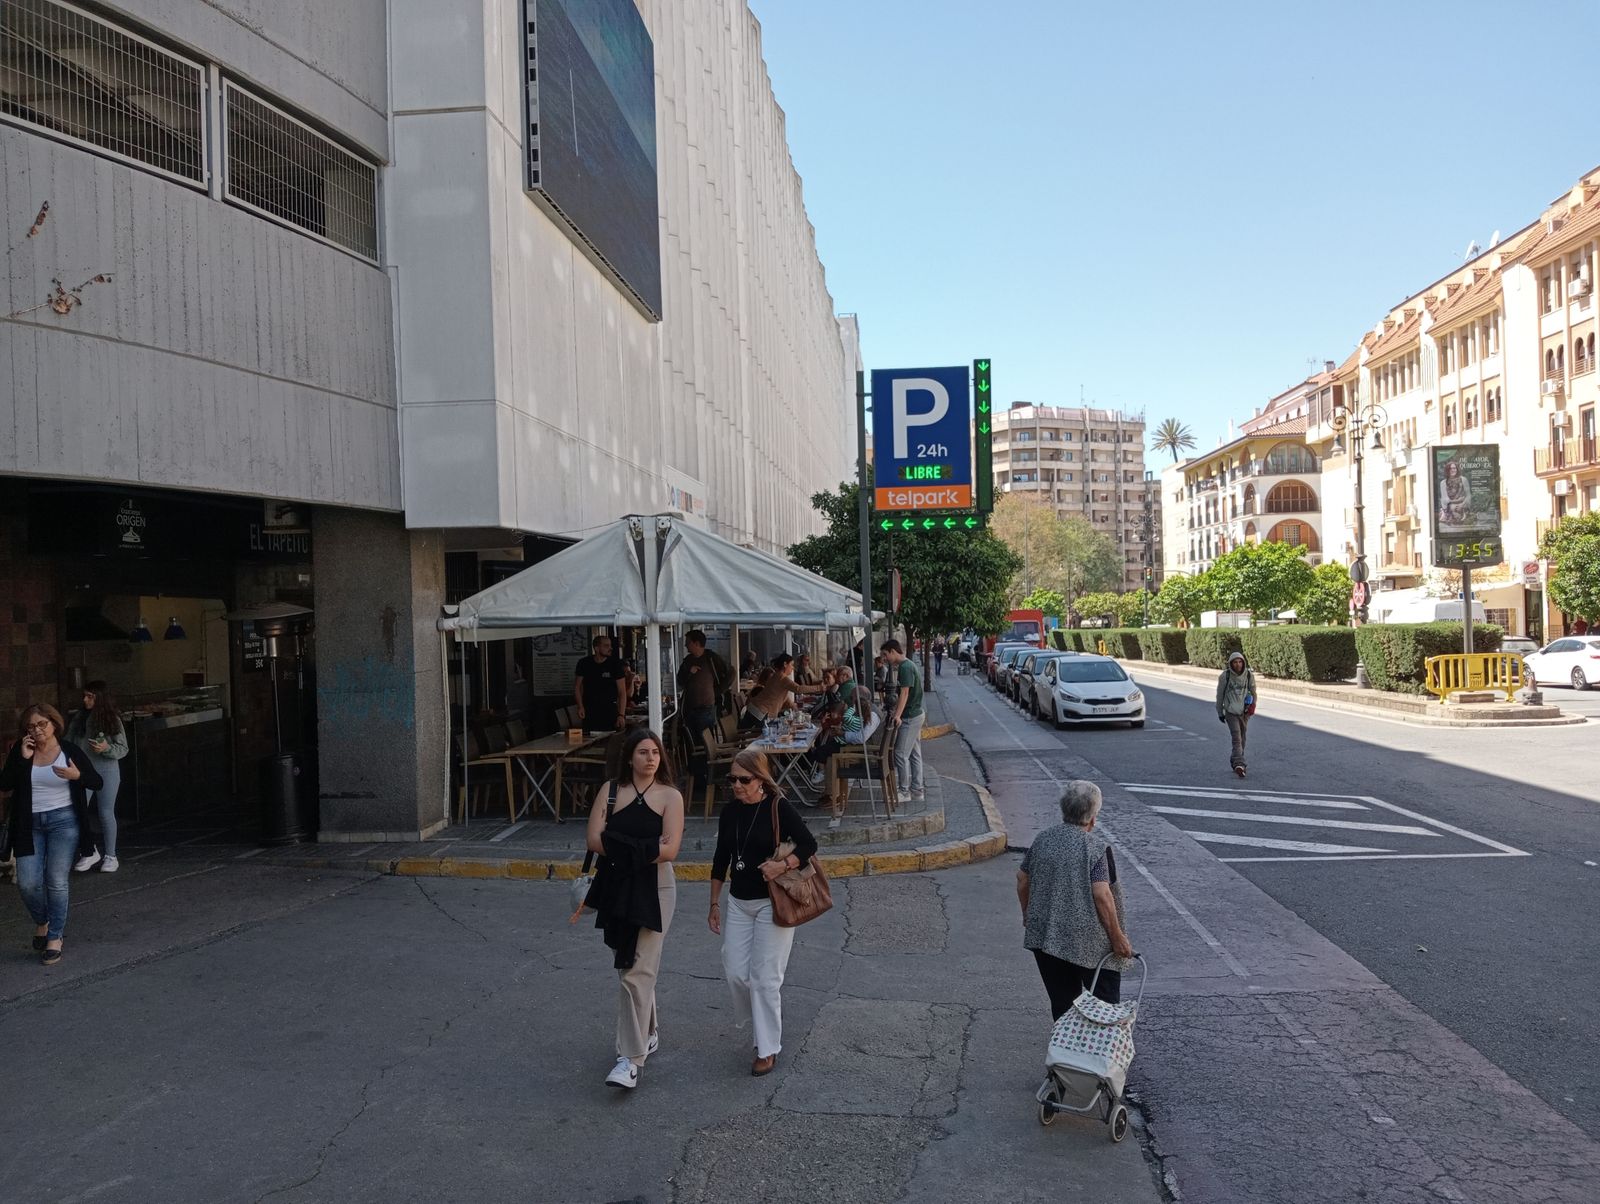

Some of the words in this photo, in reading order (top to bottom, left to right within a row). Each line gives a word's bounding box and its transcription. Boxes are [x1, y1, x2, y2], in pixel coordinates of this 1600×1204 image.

[892, 378, 950, 459] P
[917, 444, 948, 458] 24h
[905, 466, 942, 480] LIBRE
[888, 489, 959, 509] telpark
[116, 514, 146, 528] ORIGEN
[250, 523, 264, 551] EL
[1448, 544, 1494, 558] 13:55
